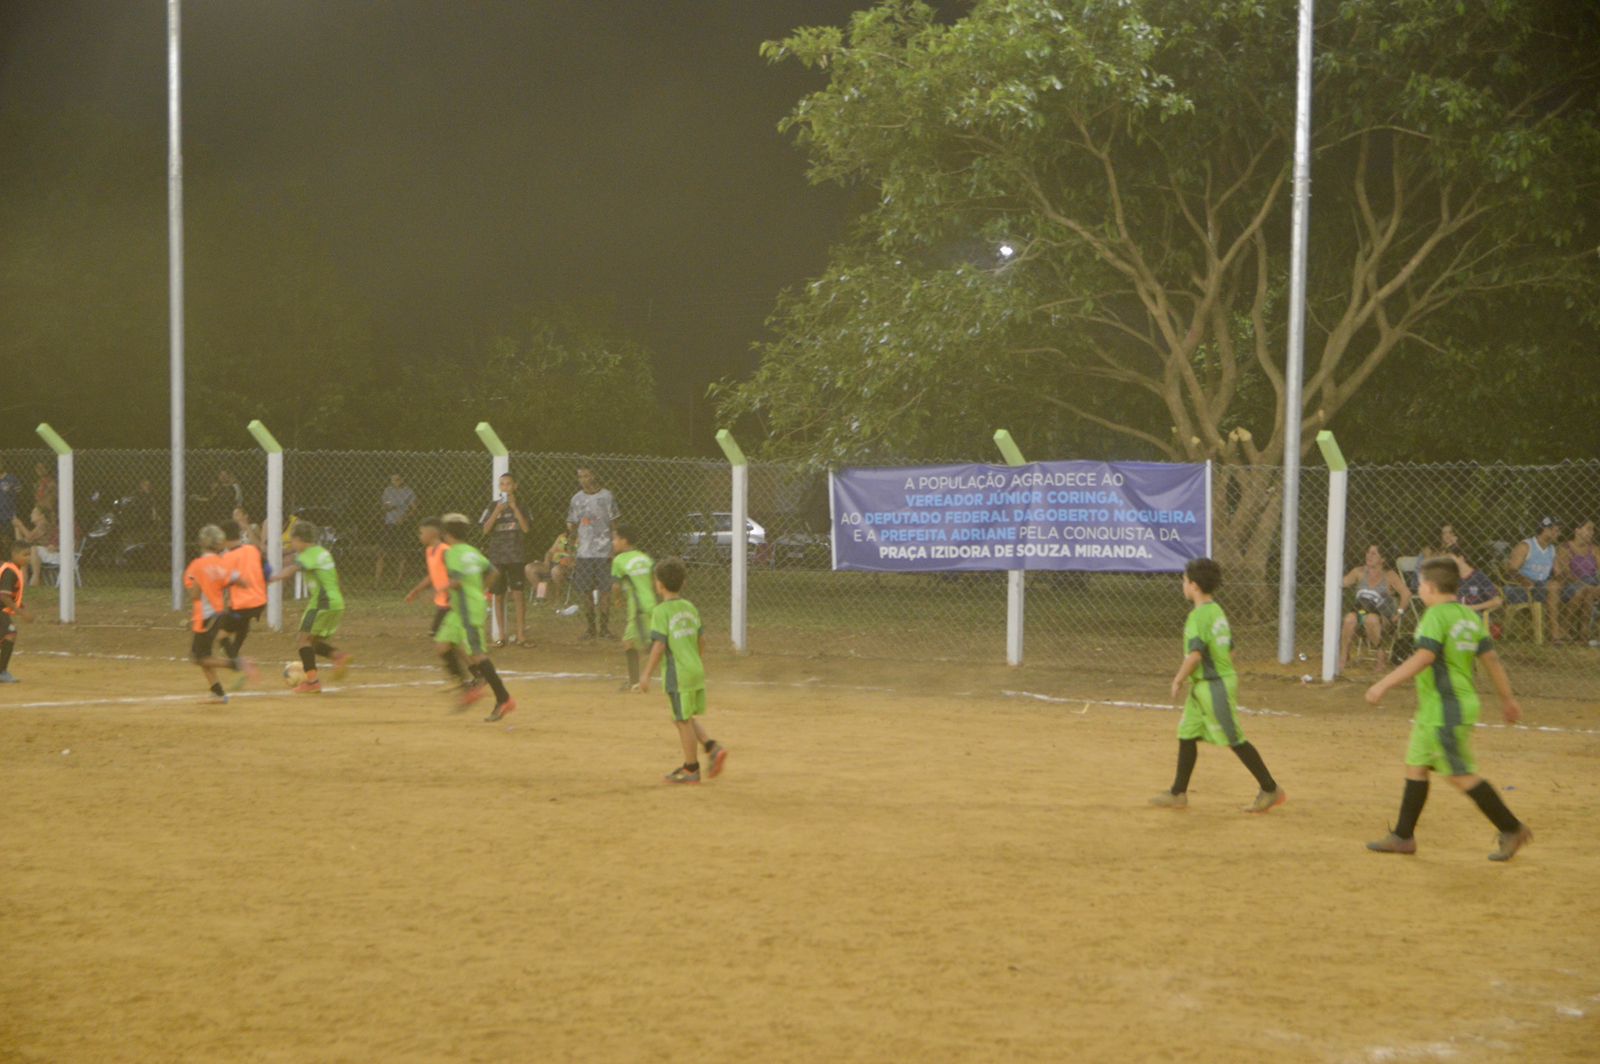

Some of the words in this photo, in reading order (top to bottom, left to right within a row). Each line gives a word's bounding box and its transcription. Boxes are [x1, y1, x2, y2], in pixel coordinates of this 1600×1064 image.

[904, 477, 915, 490] A
[919, 473, 1006, 490] POPULAÇÃO
[1011, 473, 1097, 487] AGRADECE
[1101, 473, 1124, 487] AO
[905, 494, 983, 507] VEREADOR
[986, 490, 1042, 505] JÚNIOR
[1048, 491, 1124, 506] CORINGA,
[841, 512, 861, 525] AO
[865, 512, 941, 525] DEPUTADO
[945, 510, 1009, 524] FEDERAL
[1013, 509, 1109, 523] DAGOBERTO
[1113, 509, 1196, 524] NOGUEIRA
[853, 529, 862, 542] E
[866, 530, 877, 542] A
[880, 529, 947, 541] PREFEITA
[950, 527, 1016, 541] ADRIANE
[1019, 526, 1060, 540] PELA
[1063, 526, 1156, 541] CONQUISTA
[1160, 528, 1180, 541] DA
[879, 546, 927, 560] PRAÇA
[931, 545, 991, 558] IZIDORA
[994, 544, 1013, 557] DE
[1016, 544, 1072, 557] SOUZA
[1075, 544, 1152, 558] MIRANDA.
